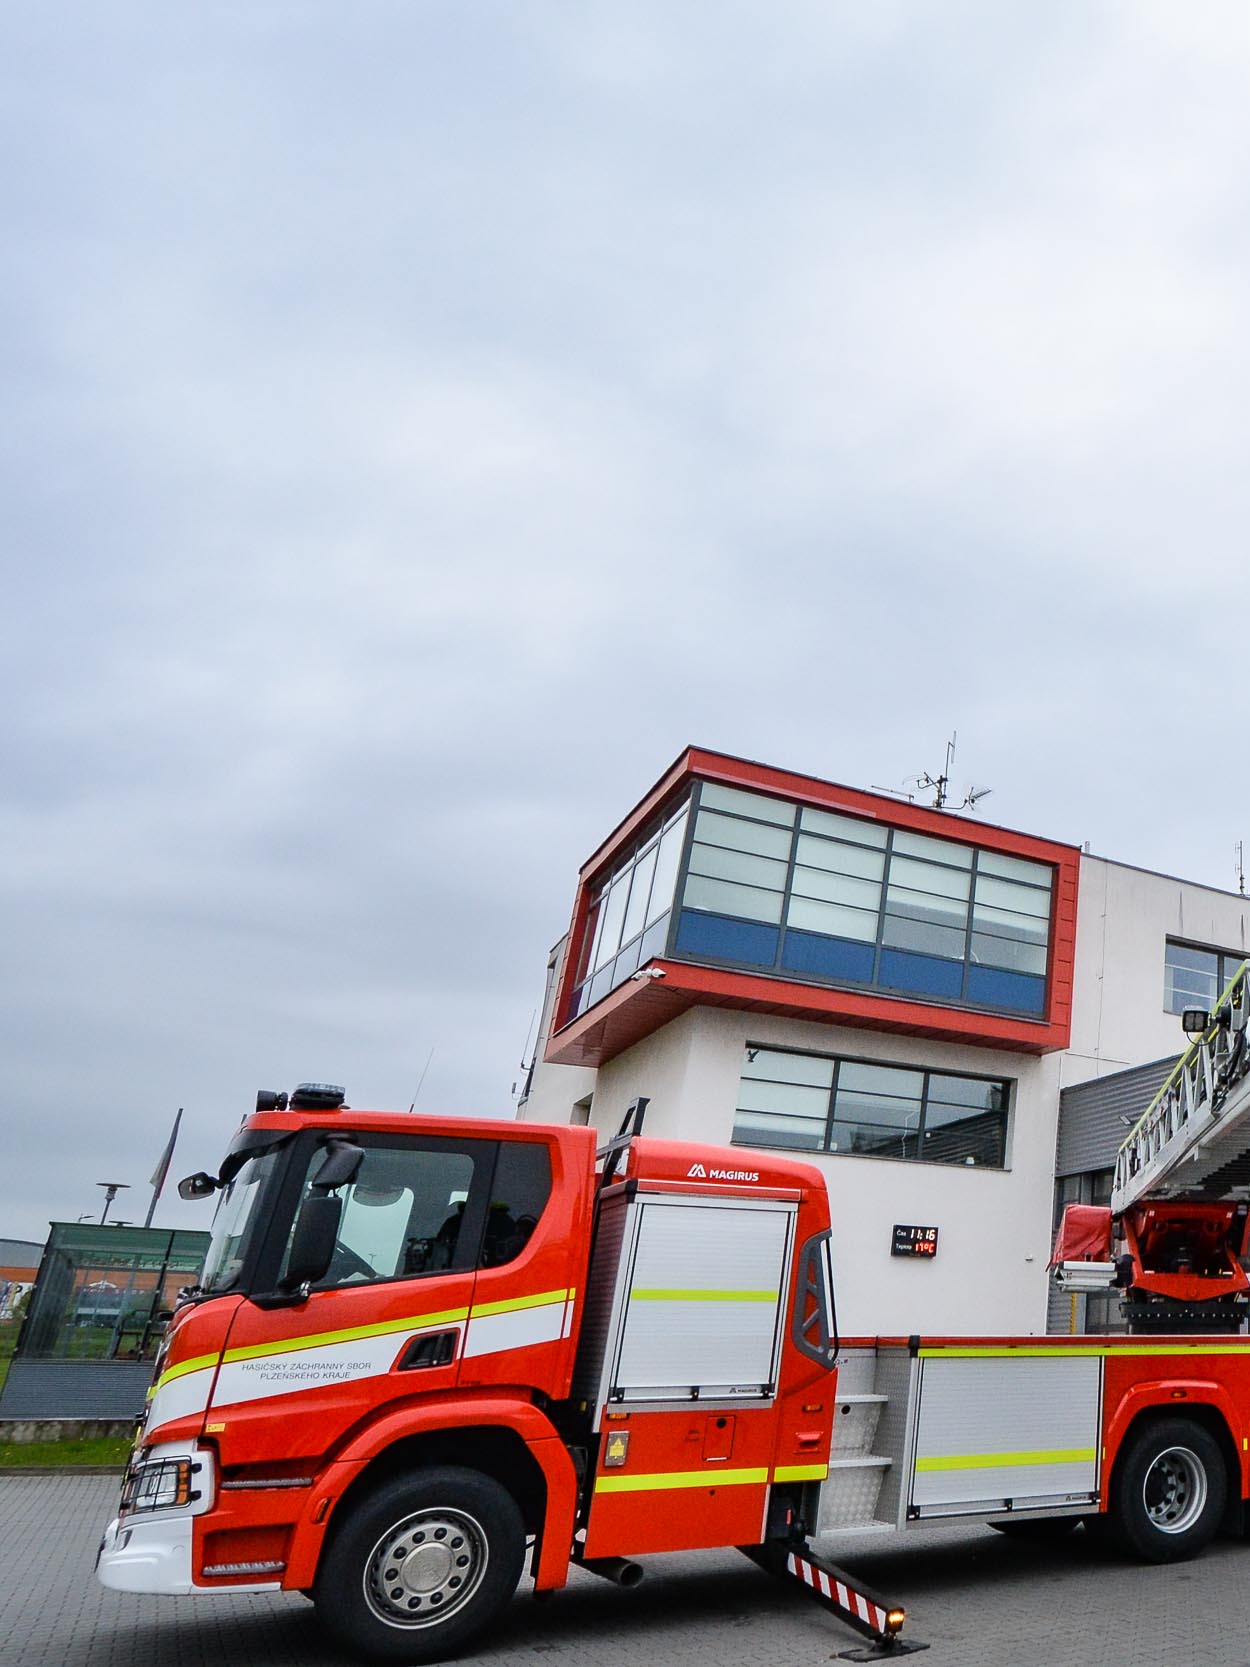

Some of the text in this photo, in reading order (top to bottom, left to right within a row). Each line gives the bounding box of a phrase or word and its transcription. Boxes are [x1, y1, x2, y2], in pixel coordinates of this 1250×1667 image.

[709, 1169, 759, 1182] MAGIRUS
[910, 1228, 936, 1241] 11:16
[346, 1361, 372, 1370] SBOR
[322, 1371, 351, 1379] KRAJE
